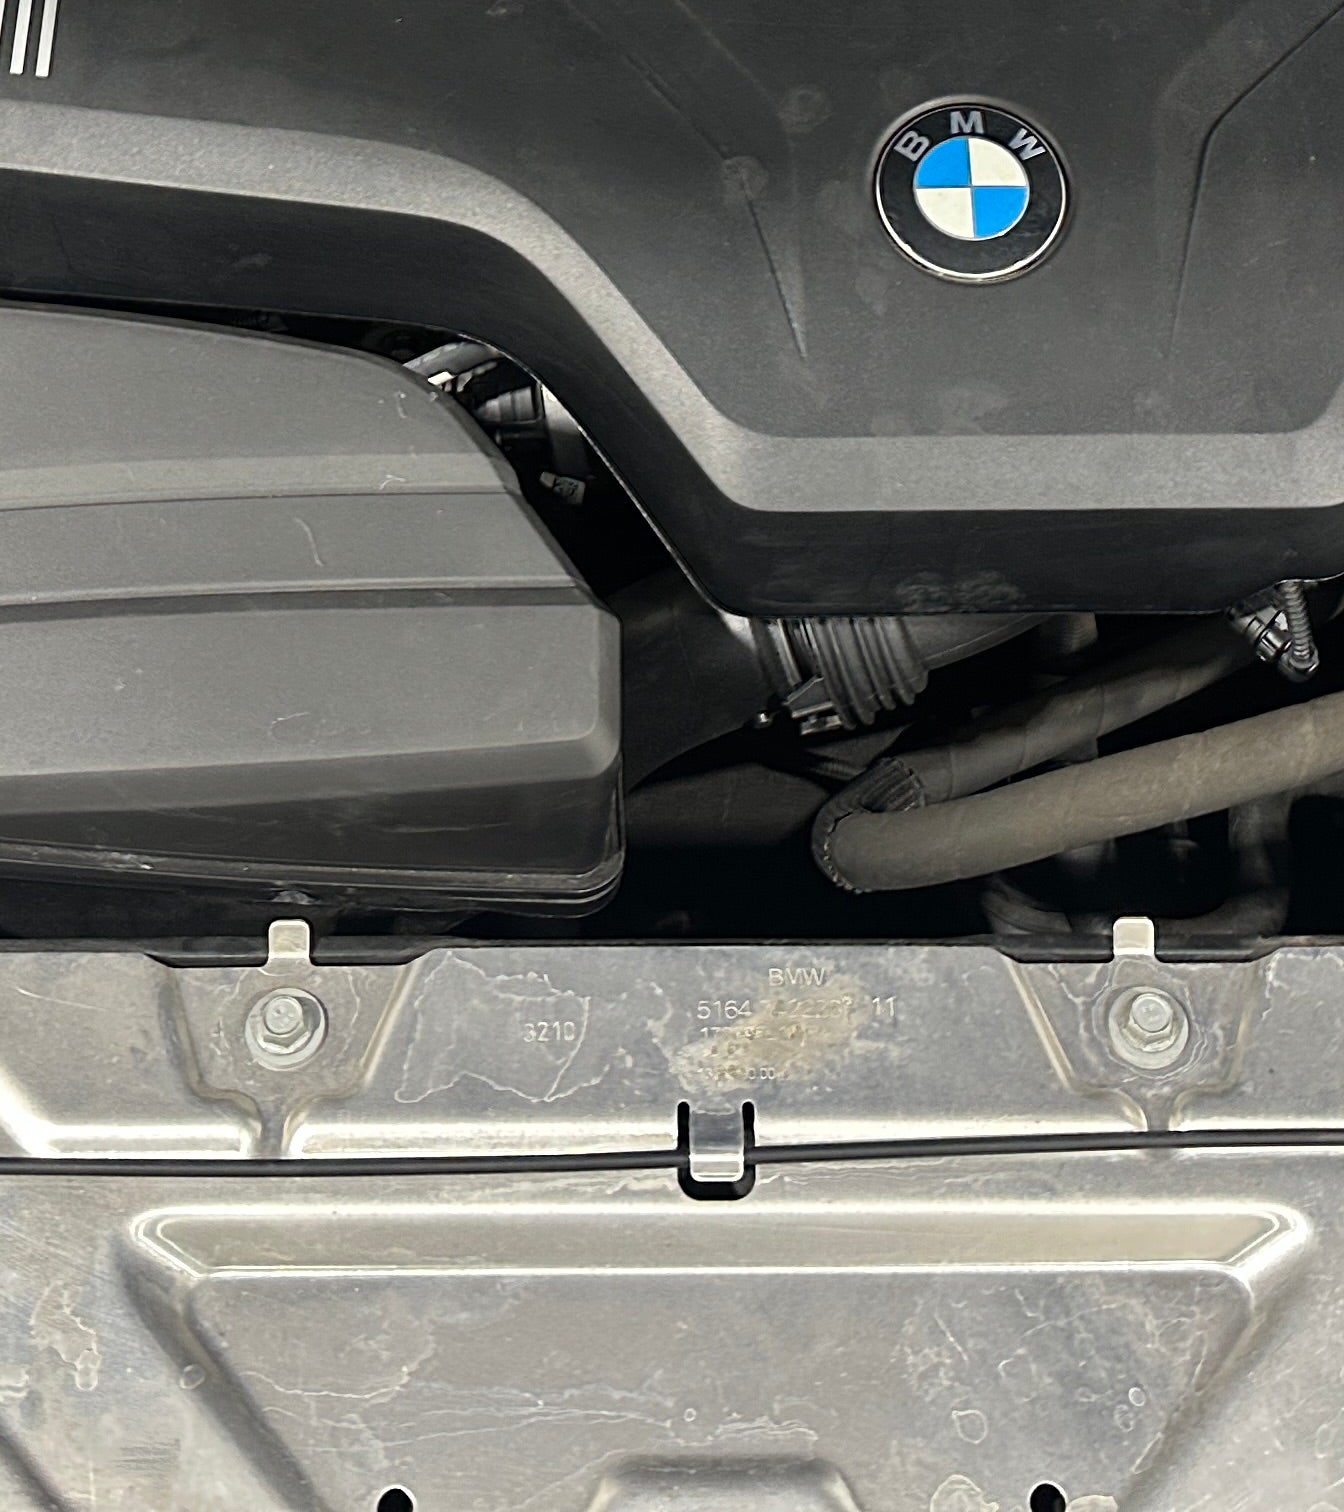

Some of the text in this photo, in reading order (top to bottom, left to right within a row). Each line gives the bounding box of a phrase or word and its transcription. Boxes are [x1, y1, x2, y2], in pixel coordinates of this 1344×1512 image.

[893, 110, 1047, 162] BMW
[768, 967, 825, 987] BMW
[697, 999, 752, 1020] 5164
